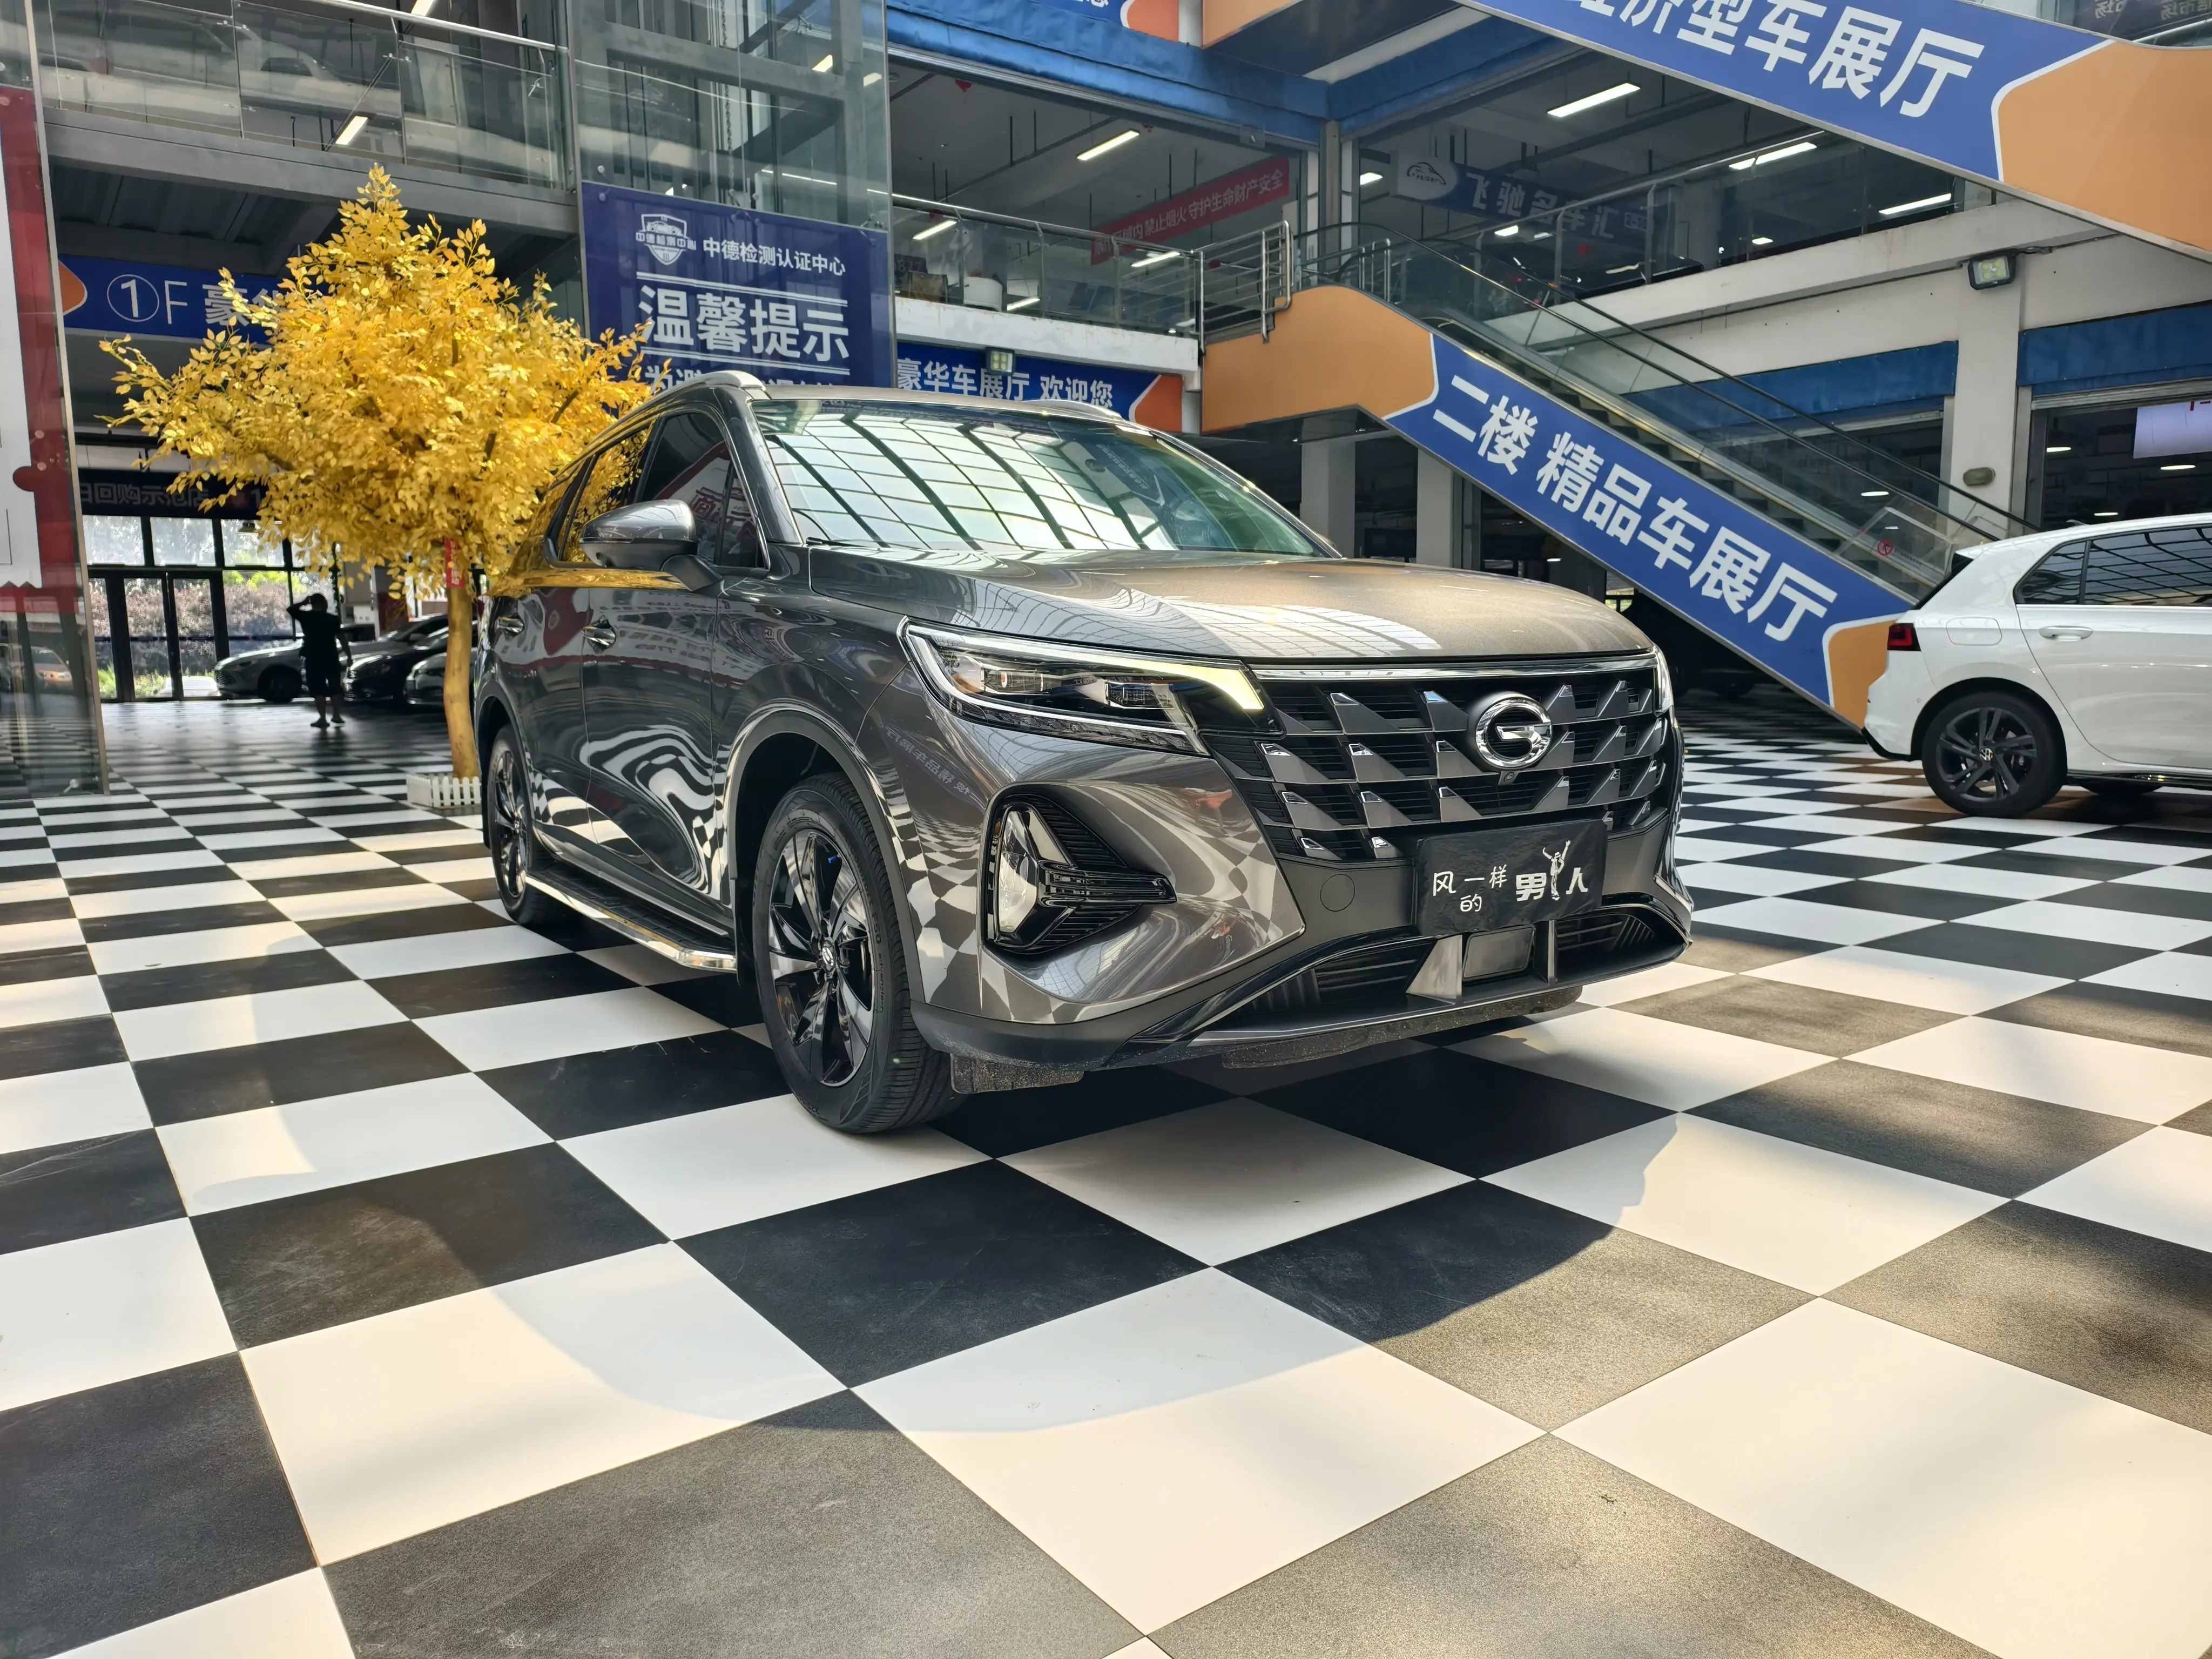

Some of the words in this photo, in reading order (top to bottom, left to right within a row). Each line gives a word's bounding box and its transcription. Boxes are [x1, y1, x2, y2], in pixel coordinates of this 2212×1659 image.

[1580, 0, 1985, 118] 型车展厅
[1188, 168, 1284, 220] 守护生命财产安全
[703, 237, 846, 276] 中德检测认证中心
[638, 284, 850, 362] 温馨提示
[897, 358, 1030, 402] 豪华车展厅
[1040, 375, 1114, 408] 欢迎您
[1433, 375, 1538, 475] 二楼
[1536, 431, 1838, 642] 精品车展厅
[1460, 893, 1482, 912] 的
[1515, 867, 1588, 901] 男人
